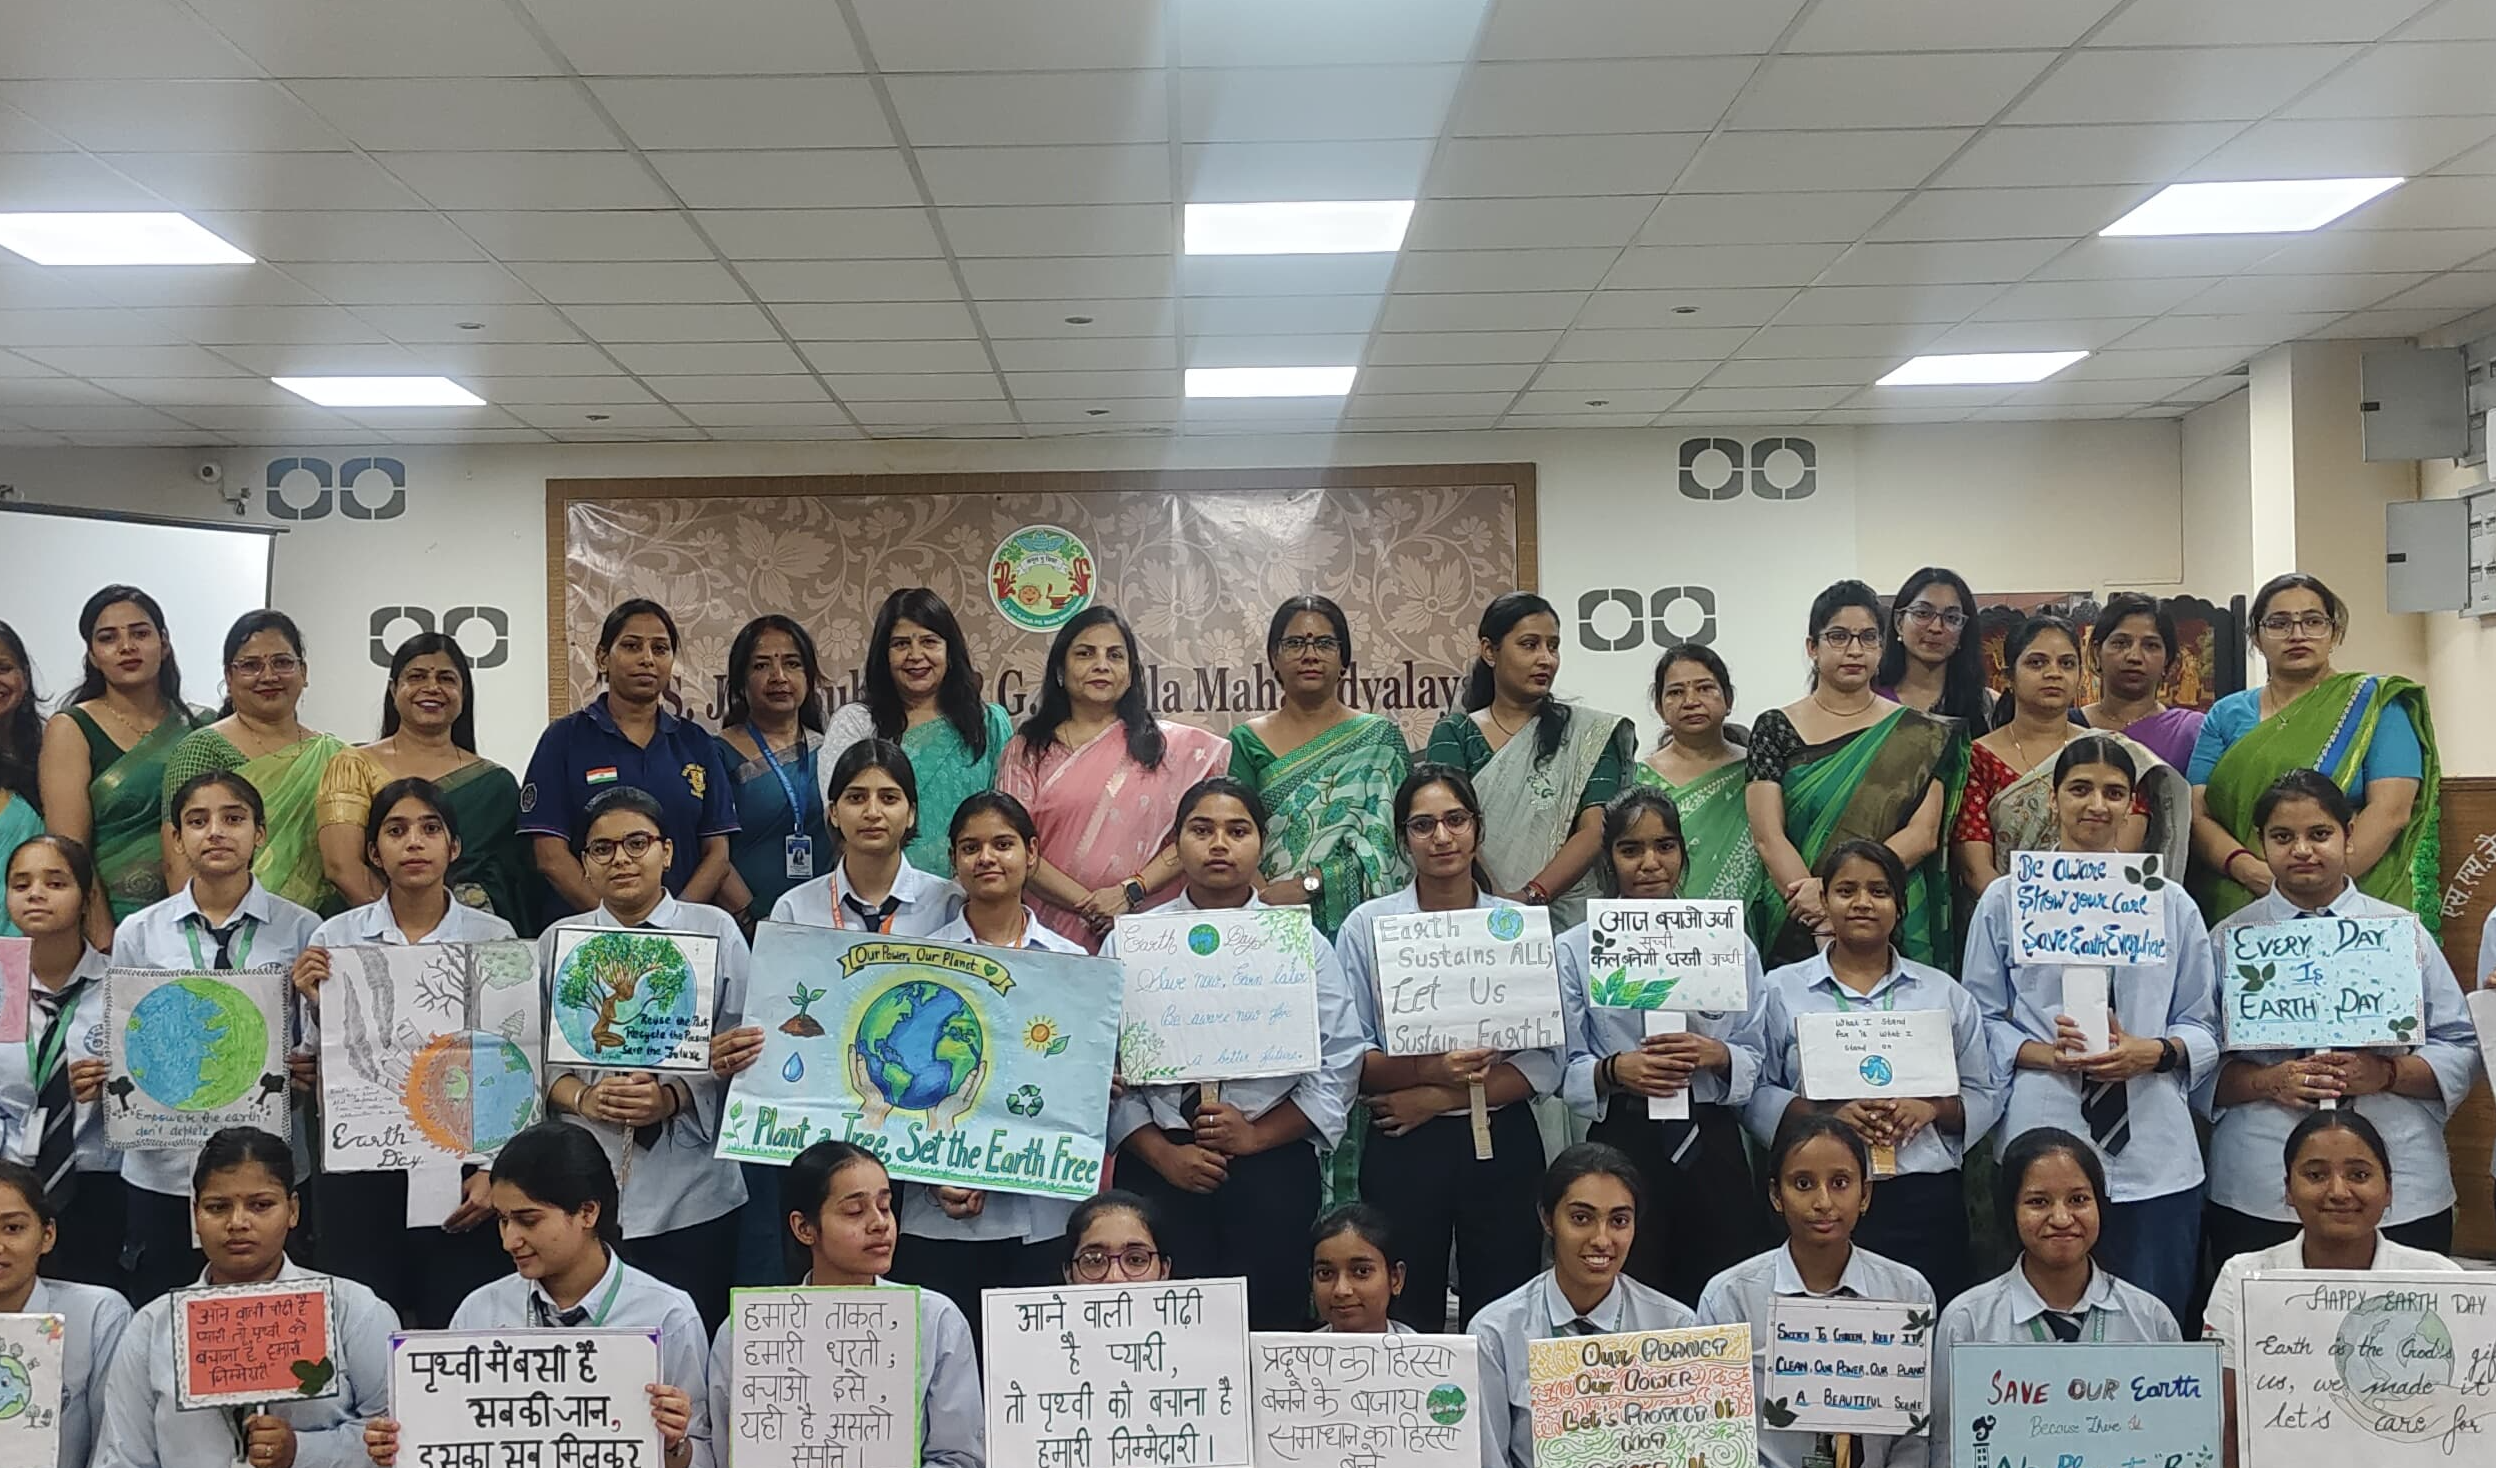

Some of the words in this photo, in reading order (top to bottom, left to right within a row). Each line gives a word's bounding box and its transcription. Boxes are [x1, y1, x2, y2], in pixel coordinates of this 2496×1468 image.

[1193, 660, 1472, 718] Mahdyalay
[2018, 854, 2044, 882] Be
[2018, 885, 2069, 919] Show
[2069, 890, 2111, 914] your
[1379, 913, 1460, 942] Earth
[1599, 910, 1649, 932] आज
[1656, 906, 1703, 930] बचाओ
[1122, 924, 1178, 953] Earth
[1223, 925, 1265, 956] Day
[2022, 920, 2068, 957] Save
[2070, 923, 2105, 957] Earth
[2234, 926, 2312, 960] EVERY
[2333, 920, 2387, 956] DAY
[855, 947, 880, 963] Our
[916, 948, 939, 962] Our
[942, 951, 978, 972] Planet
[1398, 944, 1496, 968] Sustains
[1622, 947, 1658, 968] बनेगी
[1135, 965, 1187, 992] Save
[1390, 976, 1441, 1014] Let
[1470, 977, 1507, 1005] Us
[2240, 993, 2317, 1020] EARTH
[2334, 988, 2384, 1022] DAY
[640, 1013, 671, 1026] Reuse
[676, 1014, 690, 1027] the
[1161, 1004, 1181, 1027] Be
[1236, 1008, 1263, 1021] now
[1864, 1018, 1872, 1026] I
[624, 1026, 666, 1044] Recycle
[670, 1031, 684, 1042] the
[1392, 1025, 1458, 1053] Sustain
[647, 1045, 662, 1056] the
[1215, 1048, 1250, 1065] better
[201, 1110, 220, 1123] the
[332, 1122, 411, 1150] Earth
[752, 1107, 811, 1148] Plant
[896, 1121, 945, 1164] Set
[947, 1128, 980, 1169] the
[985, 1129, 1046, 1179] Earth
[1050, 1136, 1099, 1184] Free
[296, 1294, 311, 1315] है
[744, 1293, 813, 1331] हमारी
[1015, 1293, 1067, 1331] आने
[1084, 1291, 1133, 1329] वाली
[1153, 1287, 1203, 1329] पीढ़ी
[2288, 1285, 2366, 1310] HAPPY
[2383, 1288, 2438, 1312] EARTH
[2451, 1294, 2487, 1315] DAY
[196, 1347, 239, 1366] बचाना
[242, 1340, 257, 1362] है
[744, 1331, 806, 1366] हमारी
[1060, 1331, 1081, 1375] है
[1261, 1345, 1335, 1380] प्रदूषण
[1338, 1346, 1379, 1382] का
[1383, 1334, 1457, 1378] हिस्सा
[2256, 1335, 2313, 1356] Earth
[2328, 1339, 2346, 1356] is
[2358, 1336, 2384, 1357] the
[2401, 1338, 2453, 1360] God's
[407, 1344, 484, 1392] पृथ्वी
[485, 1340, 513, 1382] में
[513, 1344, 571, 1382] बसी
[576, 1340, 598, 1383] है
[742, 1367, 812, 1404] बचाओ
[1261, 1379, 1307, 1412] बनने
[1312, 1377, 1341, 1417] के
[1351, 1389, 1425, 1416] बजाय
[1796, 1390, 1807, 1403] A
[1824, 1388, 1882, 1408] BEAUTIFUL
[1895, 1396, 1922, 1409] SCENE
[1987, 1370, 2051, 1405] SAVE
[2068, 1378, 2120, 1400] OUR
[2131, 1375, 2201, 1401] Earth
[2313, 1378, 2345, 1392] we
[2361, 1374, 2434, 1394] made
[2461, 1377, 2491, 1396] it
[1004, 1381, 1027, 1424] तो
[1037, 1381, 1095, 1432] पृथ्वी
[1108, 1380, 1133, 1418] को
[1149, 1387, 1208, 1417] बचाना
[1218, 1376, 1233, 1415] है
[1562, 1404, 1618, 1431] Let's
[740, 1403, 789, 1443] यही
[797, 1403, 817, 1439] है
[825, 1405, 894, 1441] असली
[1268, 1423, 1360, 1460] समाधान
[1364, 1425, 1397, 1447] का
[1399, 1412, 1461, 1453] हिस्सा
[2030, 1416, 2080, 1438] Because
[2264, 1402, 2331, 1429] let's
[2374, 1415, 2426, 1433] care
[2442, 1404, 2484, 1456] for
[500, 1440, 543, 1468] सब
[550, 1433, 644, 1468] मिलकर
[1036, 1427, 1092, 1468] हमारी
